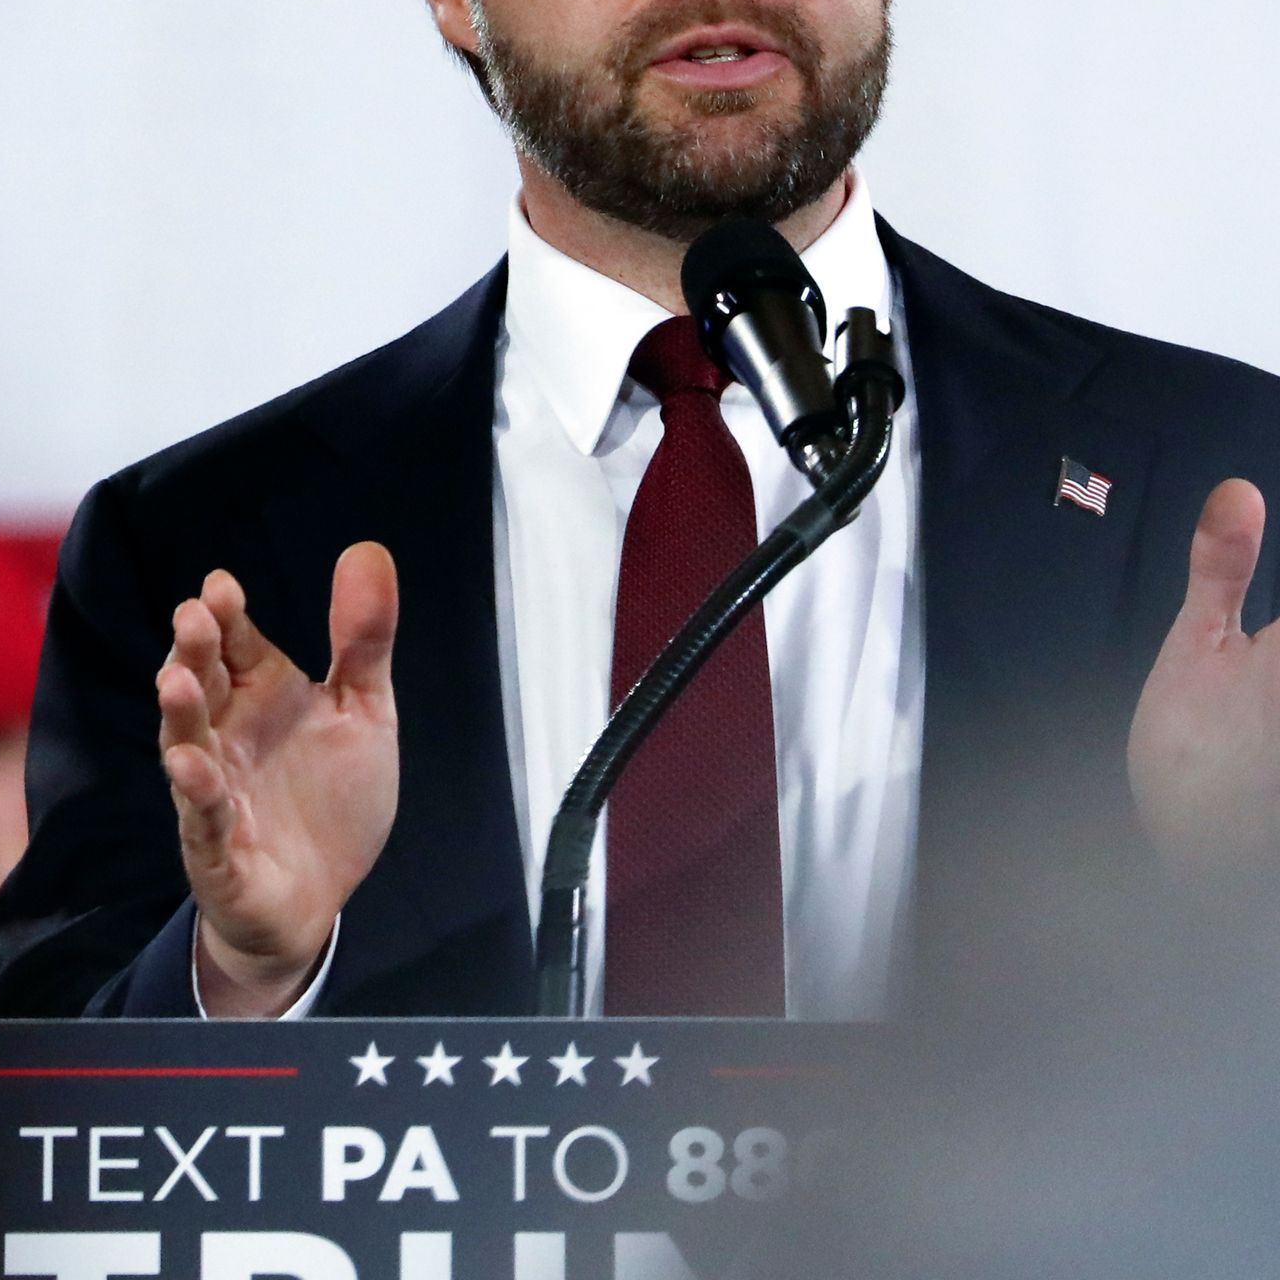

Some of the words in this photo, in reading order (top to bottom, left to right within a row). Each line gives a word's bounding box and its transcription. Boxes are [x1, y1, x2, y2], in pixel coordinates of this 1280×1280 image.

[19, 1126, 285, 1202] TEXT
[322, 1126, 460, 1202] PA
[489, 1125, 629, 1203] TO
[666, 1126, 824, 1203] 88
